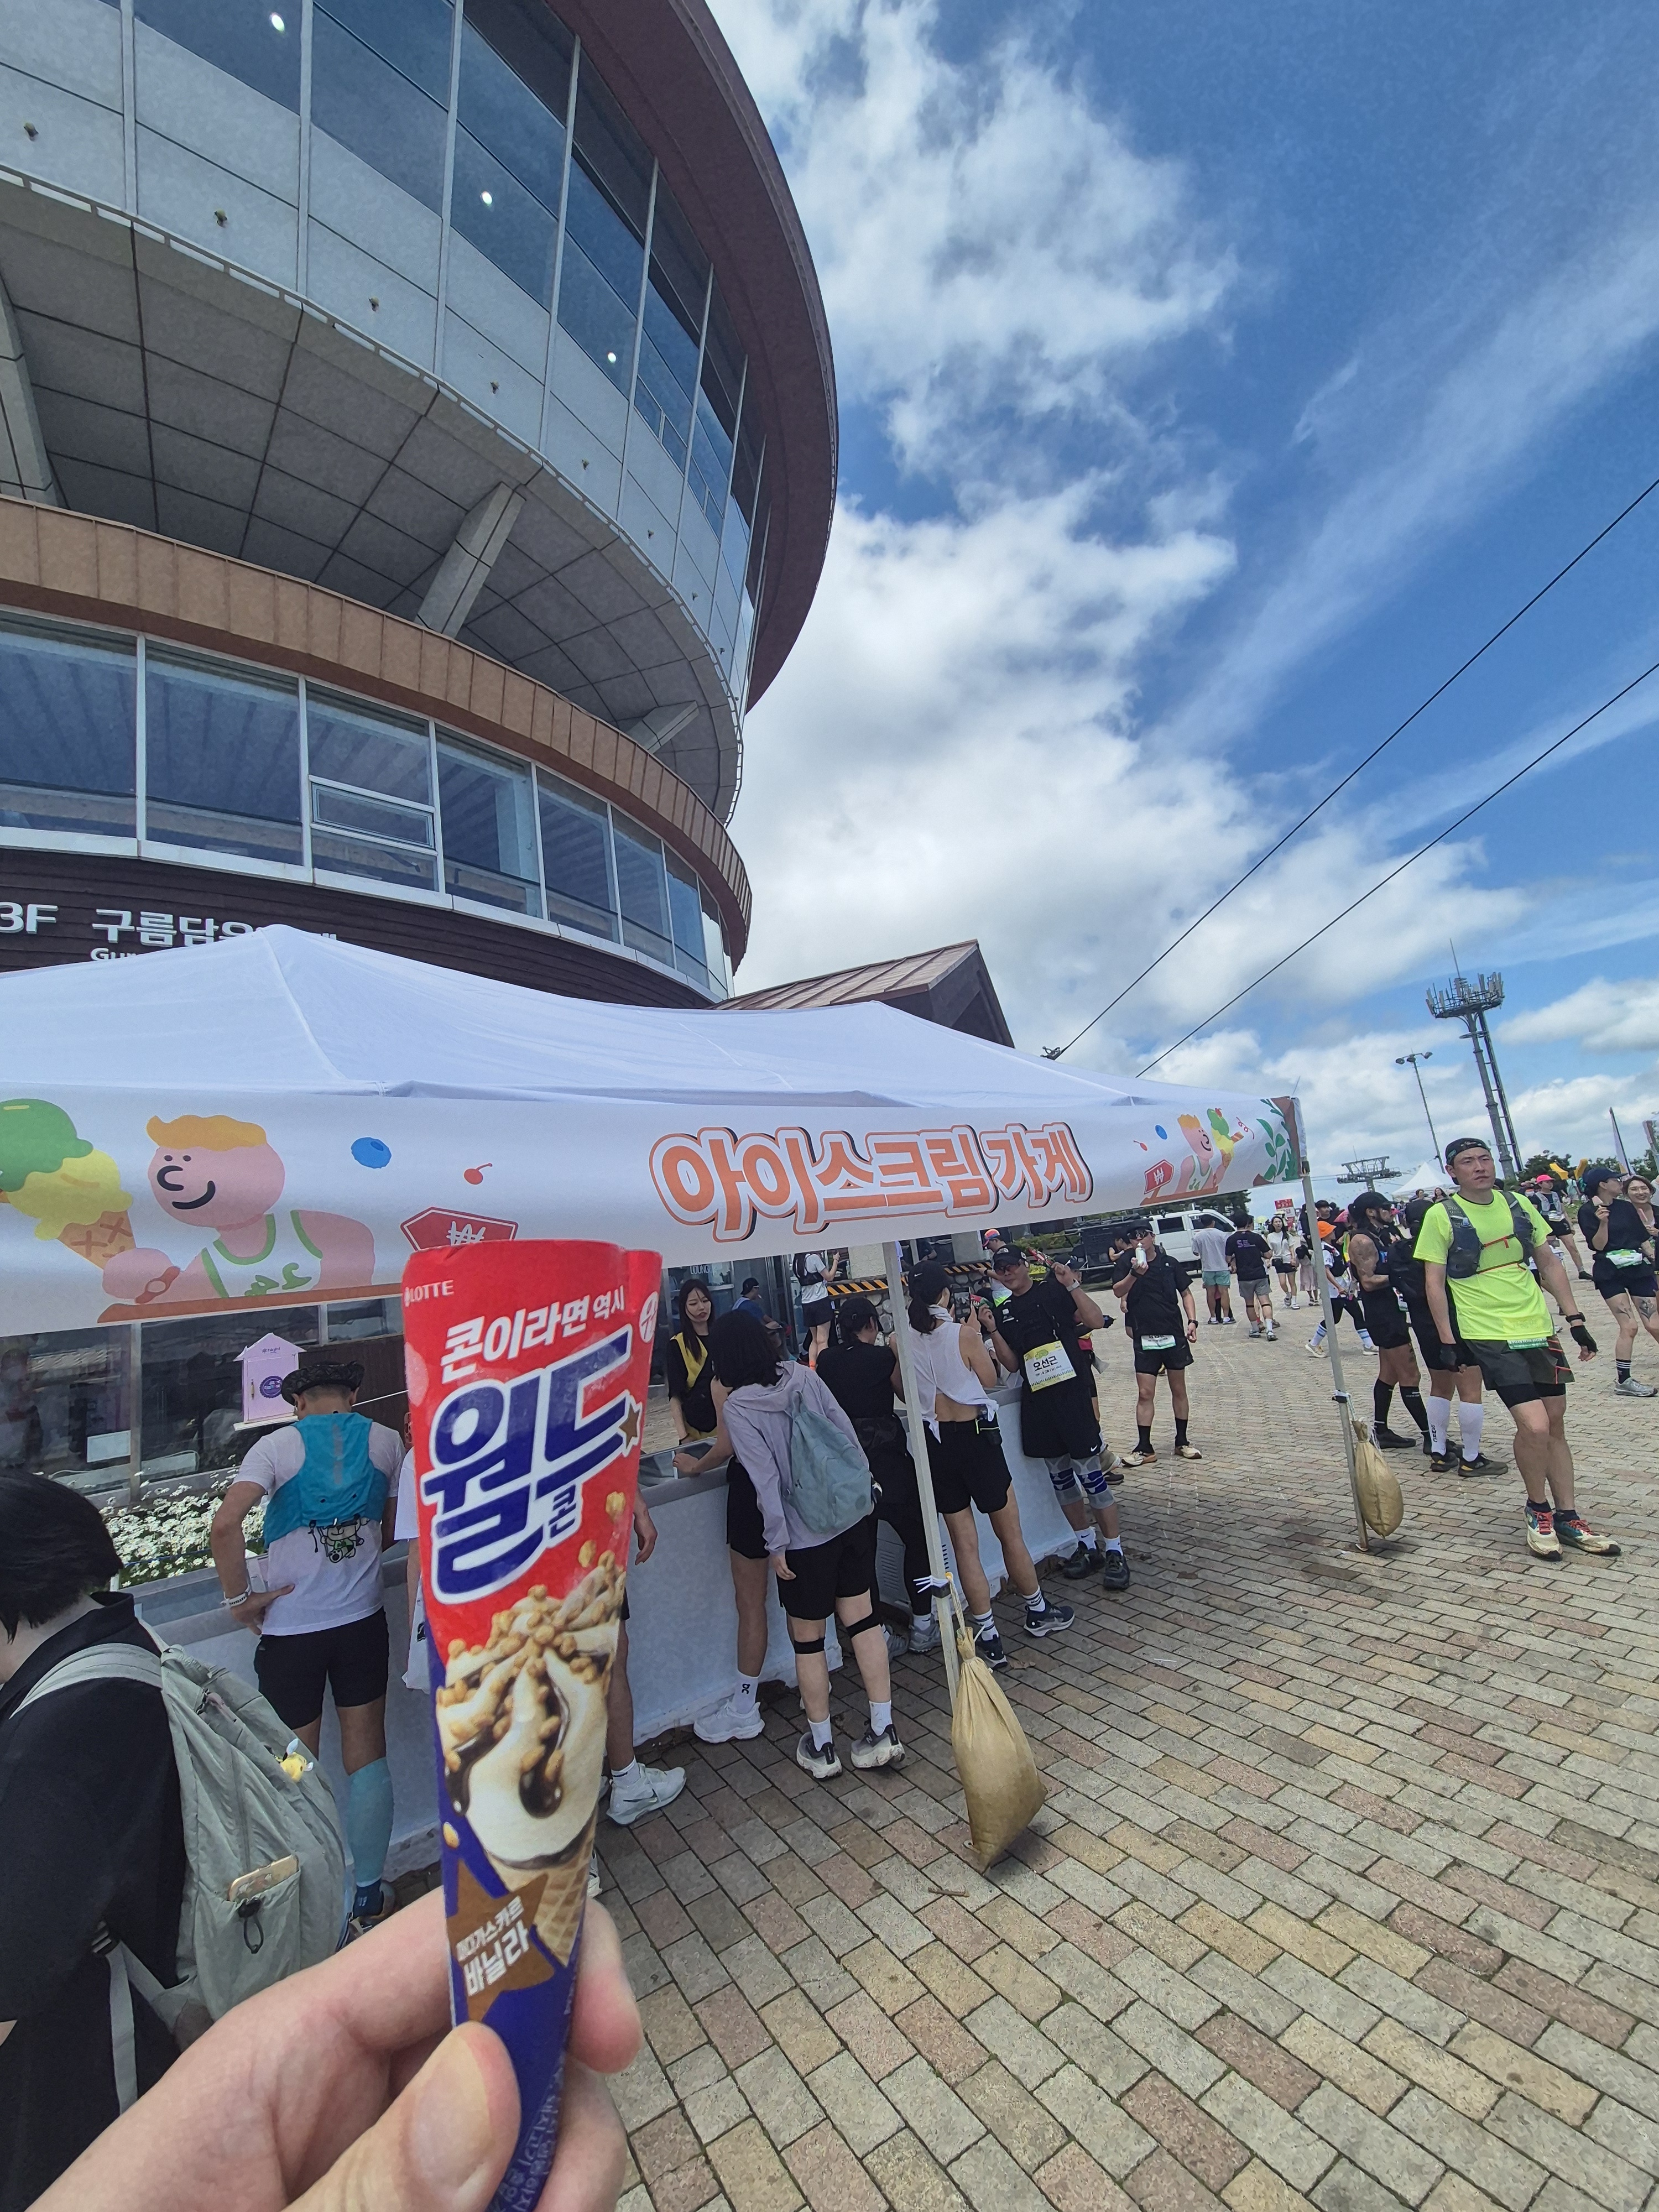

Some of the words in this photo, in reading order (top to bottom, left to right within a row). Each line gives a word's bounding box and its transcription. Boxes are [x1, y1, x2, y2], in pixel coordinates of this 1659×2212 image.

[0, 901, 58, 934] 3F
[410, 1279, 455, 1303] LOTTE
[440, 1295, 590, 1384] 콘이라면
[593, 1285, 625, 1320] 역시
[463, 1919, 530, 1997] 바닐라
